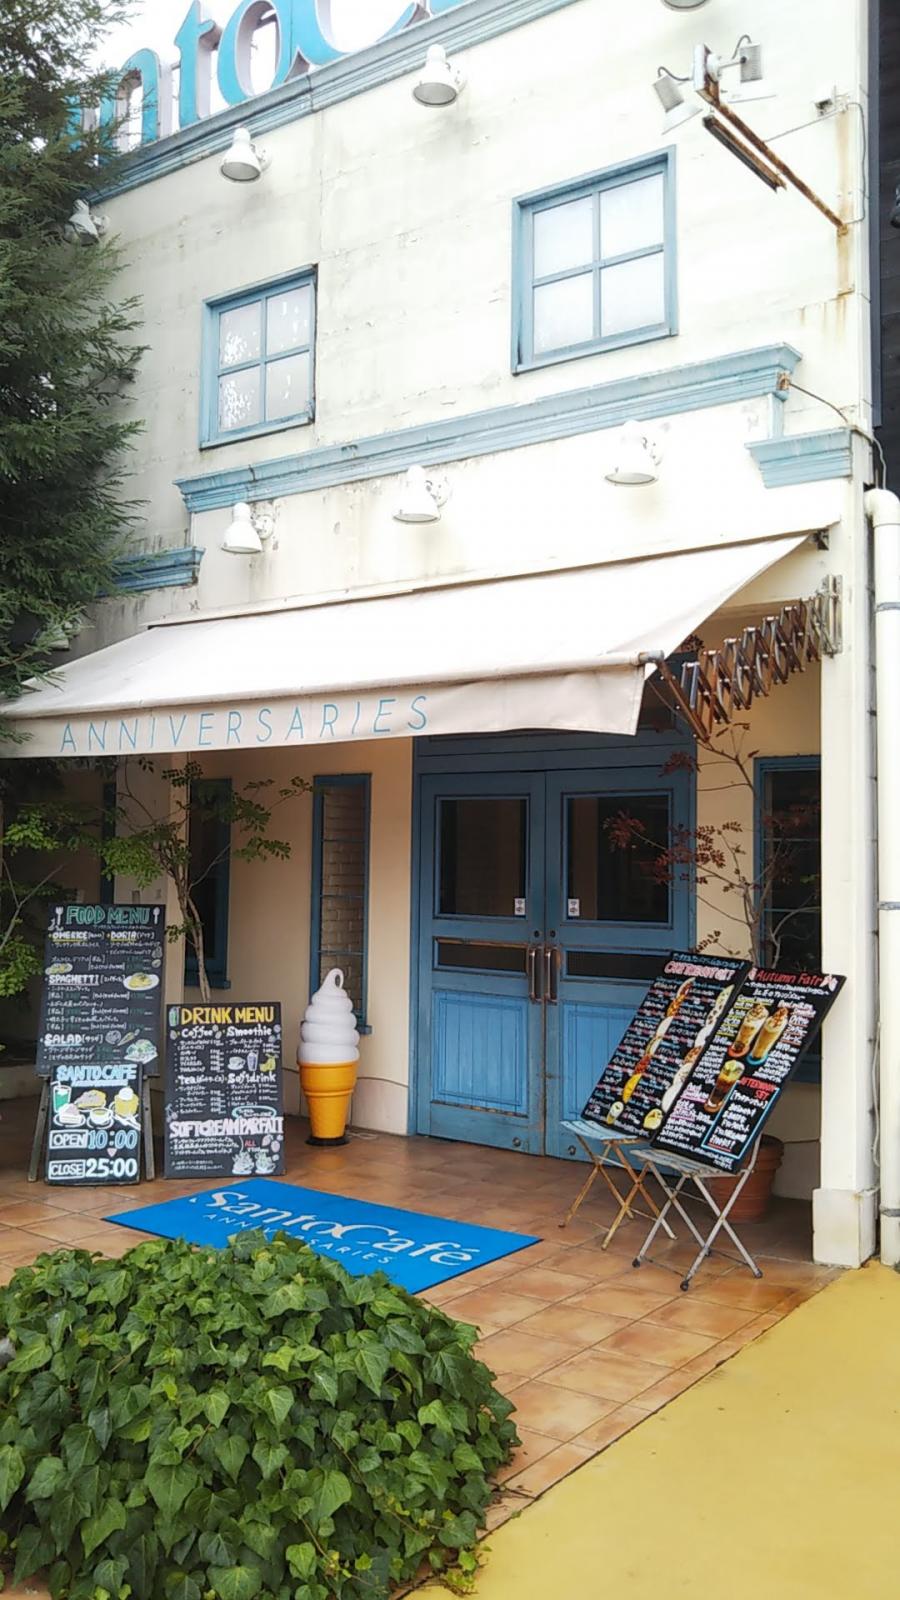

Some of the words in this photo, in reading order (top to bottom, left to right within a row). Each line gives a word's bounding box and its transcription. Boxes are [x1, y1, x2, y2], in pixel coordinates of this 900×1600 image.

[60, 695, 428, 753] ANNIVERSARIES
[65, 905, 105, 925] FOOD
[107, 906, 151, 925] MENU
[48, 974, 99, 985] SPAGHETTI
[754, 970, 797, 984] Autumn
[799, 973, 823, 987] Fair
[181, 1007, 232, 1025] DRINK
[234, 1006, 275, 1024] MENU
[181, 1026, 214, 1039] Coffee
[226, 1024, 272, 1037] Smoothie
[44, 1033, 82, 1046] SALAD
[753, 1089, 770, 1101] SET
[53, 1133, 85, 1147] OPEN
[88, 1130, 137, 1149] 10:00
[50, 1162, 83, 1176] CLOSE
[85, 1158, 138, 1178] 25:00
